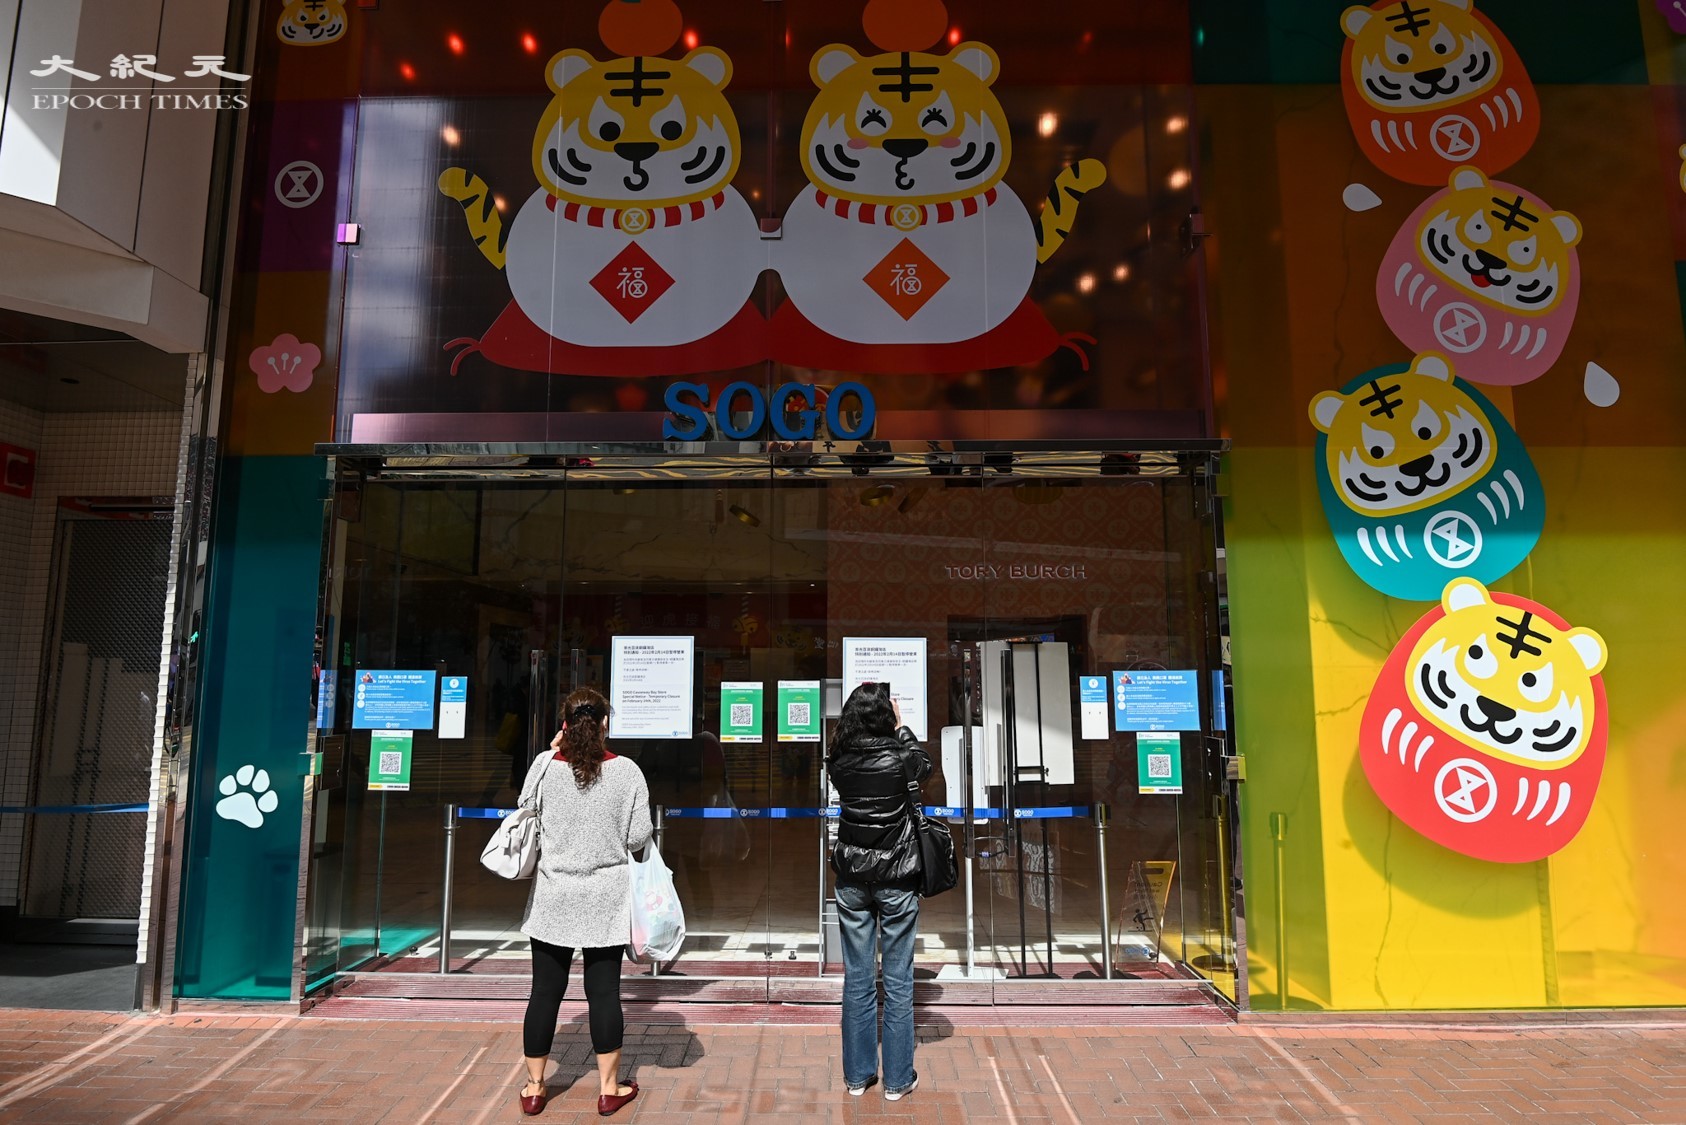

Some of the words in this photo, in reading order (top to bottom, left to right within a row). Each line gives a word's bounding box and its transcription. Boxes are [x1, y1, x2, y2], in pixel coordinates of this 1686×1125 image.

[662, 381, 876, 441] SOGO
[944, 564, 1003, 580] TORY
[1009, 564, 1088, 580] BURCH
